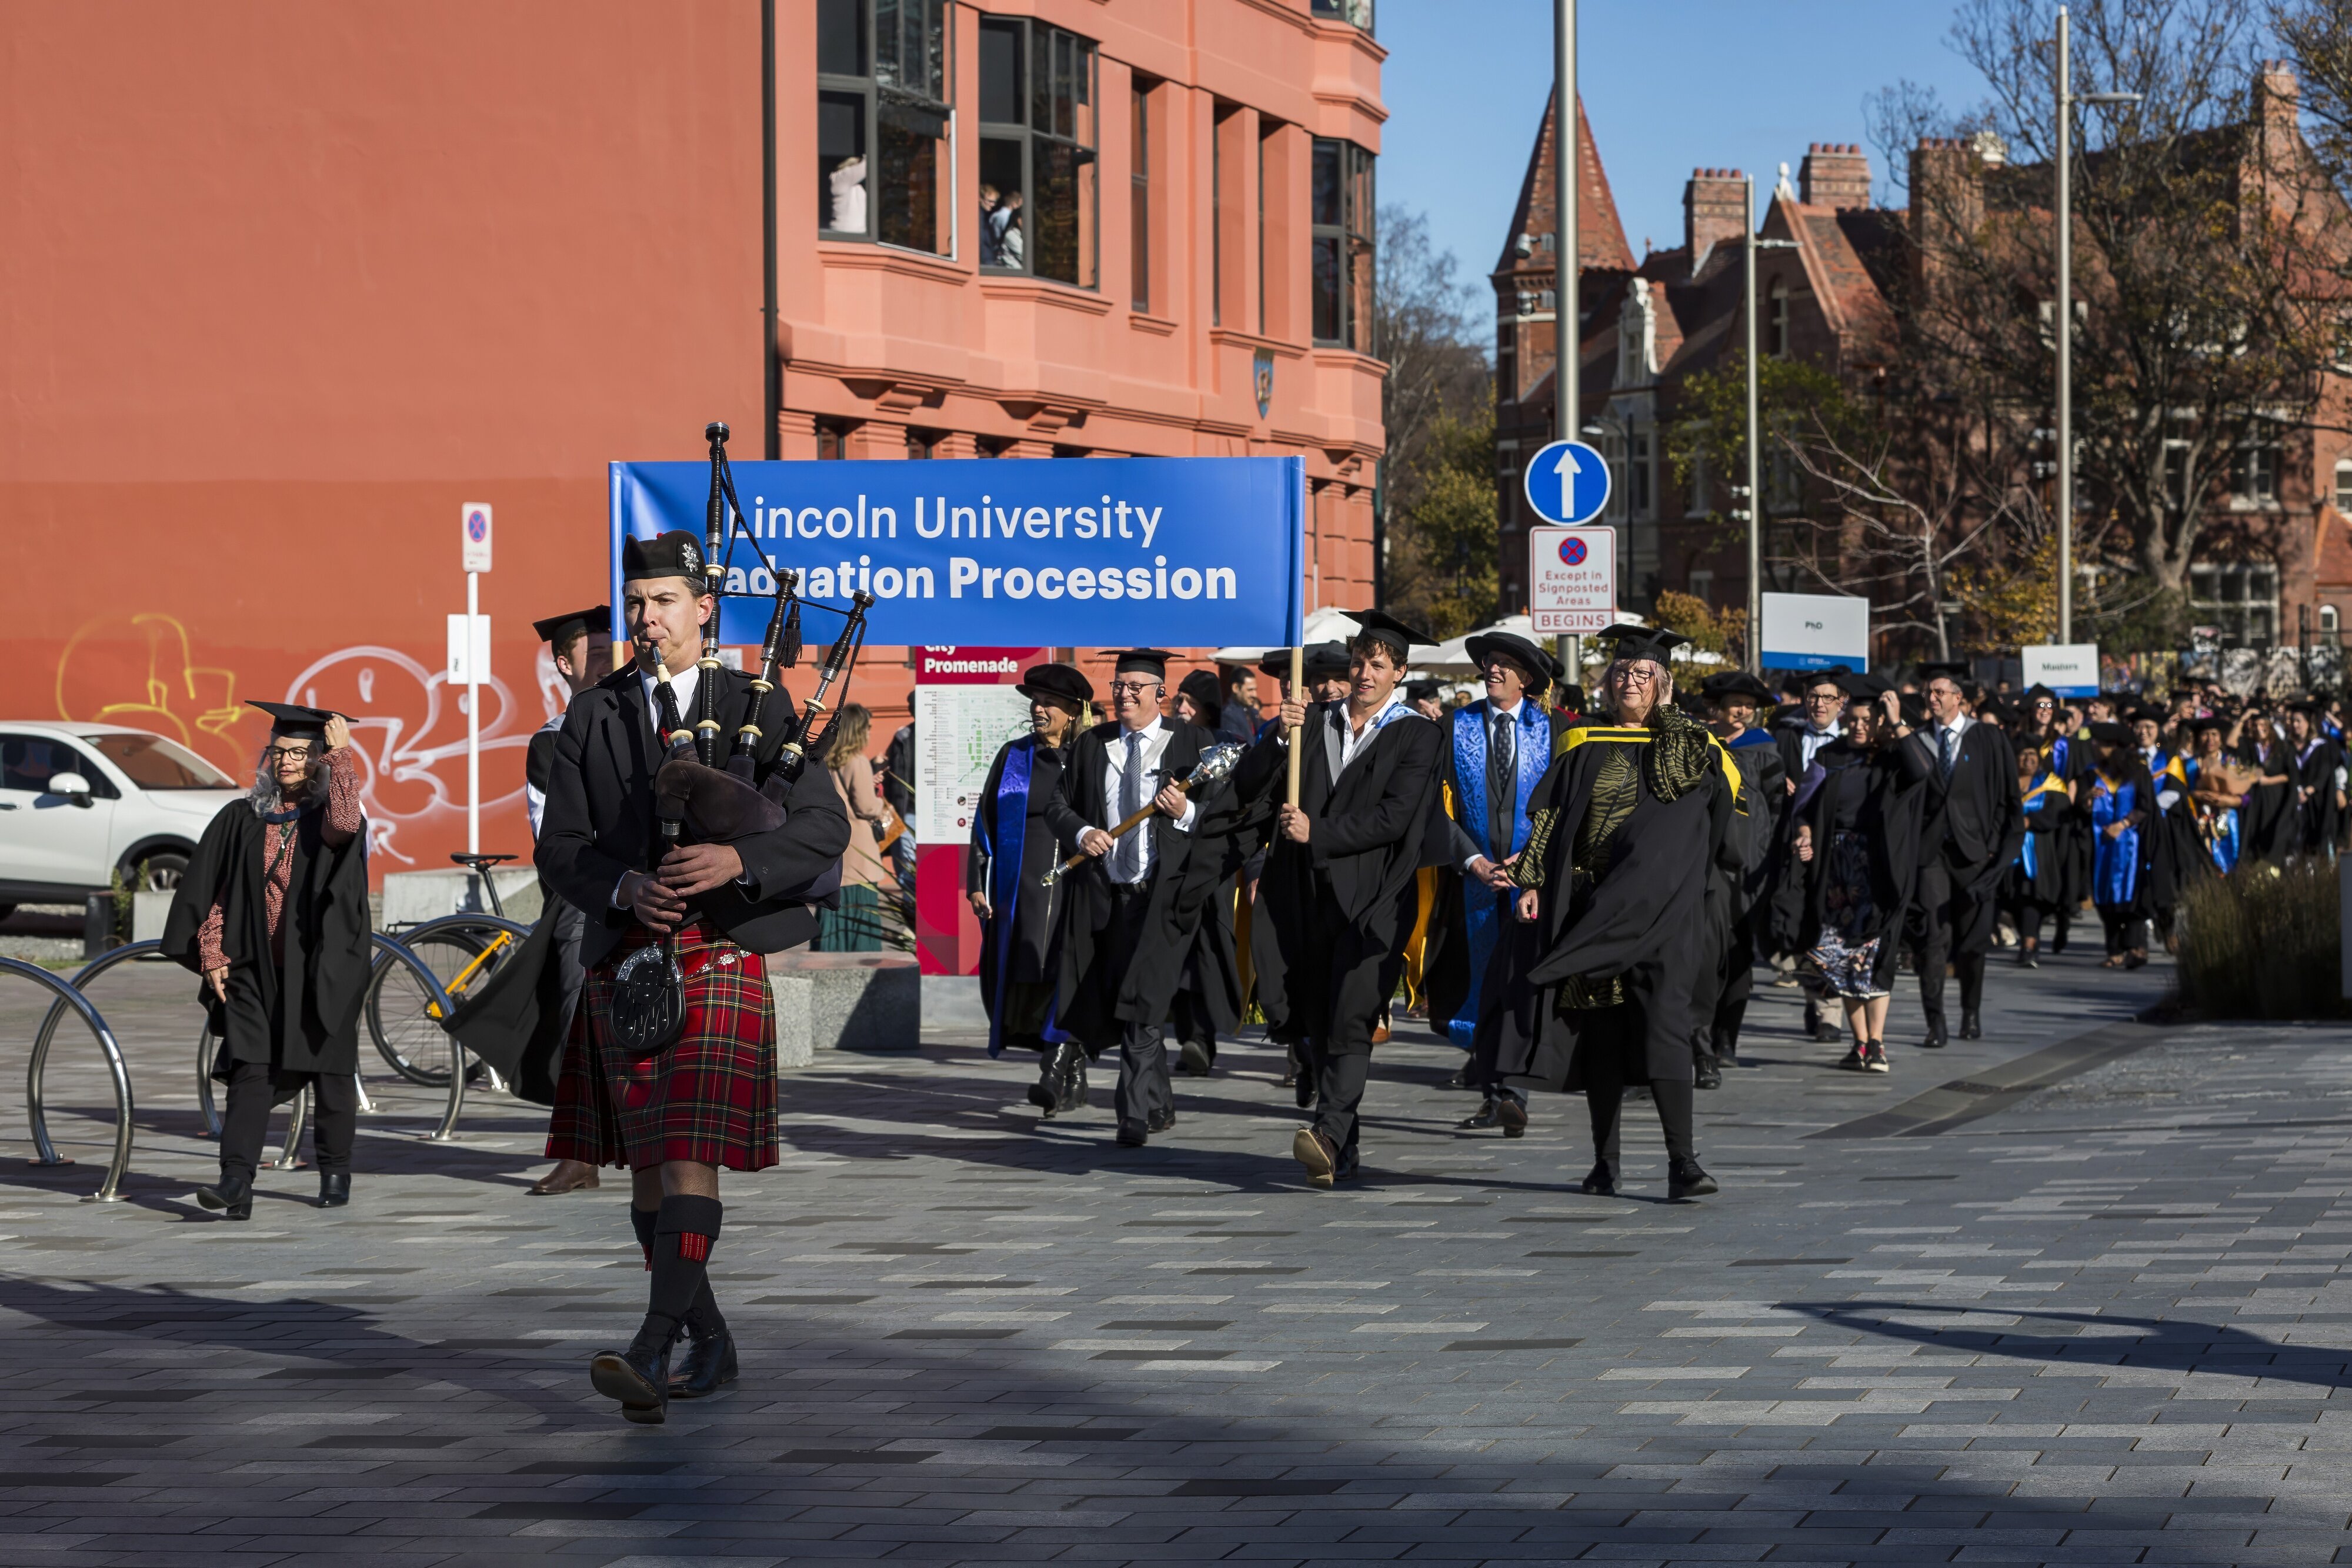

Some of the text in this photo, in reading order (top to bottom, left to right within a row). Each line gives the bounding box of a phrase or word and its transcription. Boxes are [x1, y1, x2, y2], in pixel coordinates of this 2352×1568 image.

[729, 495, 1163, 548] Lincoln University
[706, 555, 1236, 599] aduation Procession
[1545, 570, 1602, 582] Except in
[1539, 582, 1609, 595] Signposted
[1556, 595, 1590, 605] Areas
[1542, 615, 1605, 626] BEGINS
[1805, 620, 1823, 630] PhD
[925, 656, 1018, 673] Promenade
